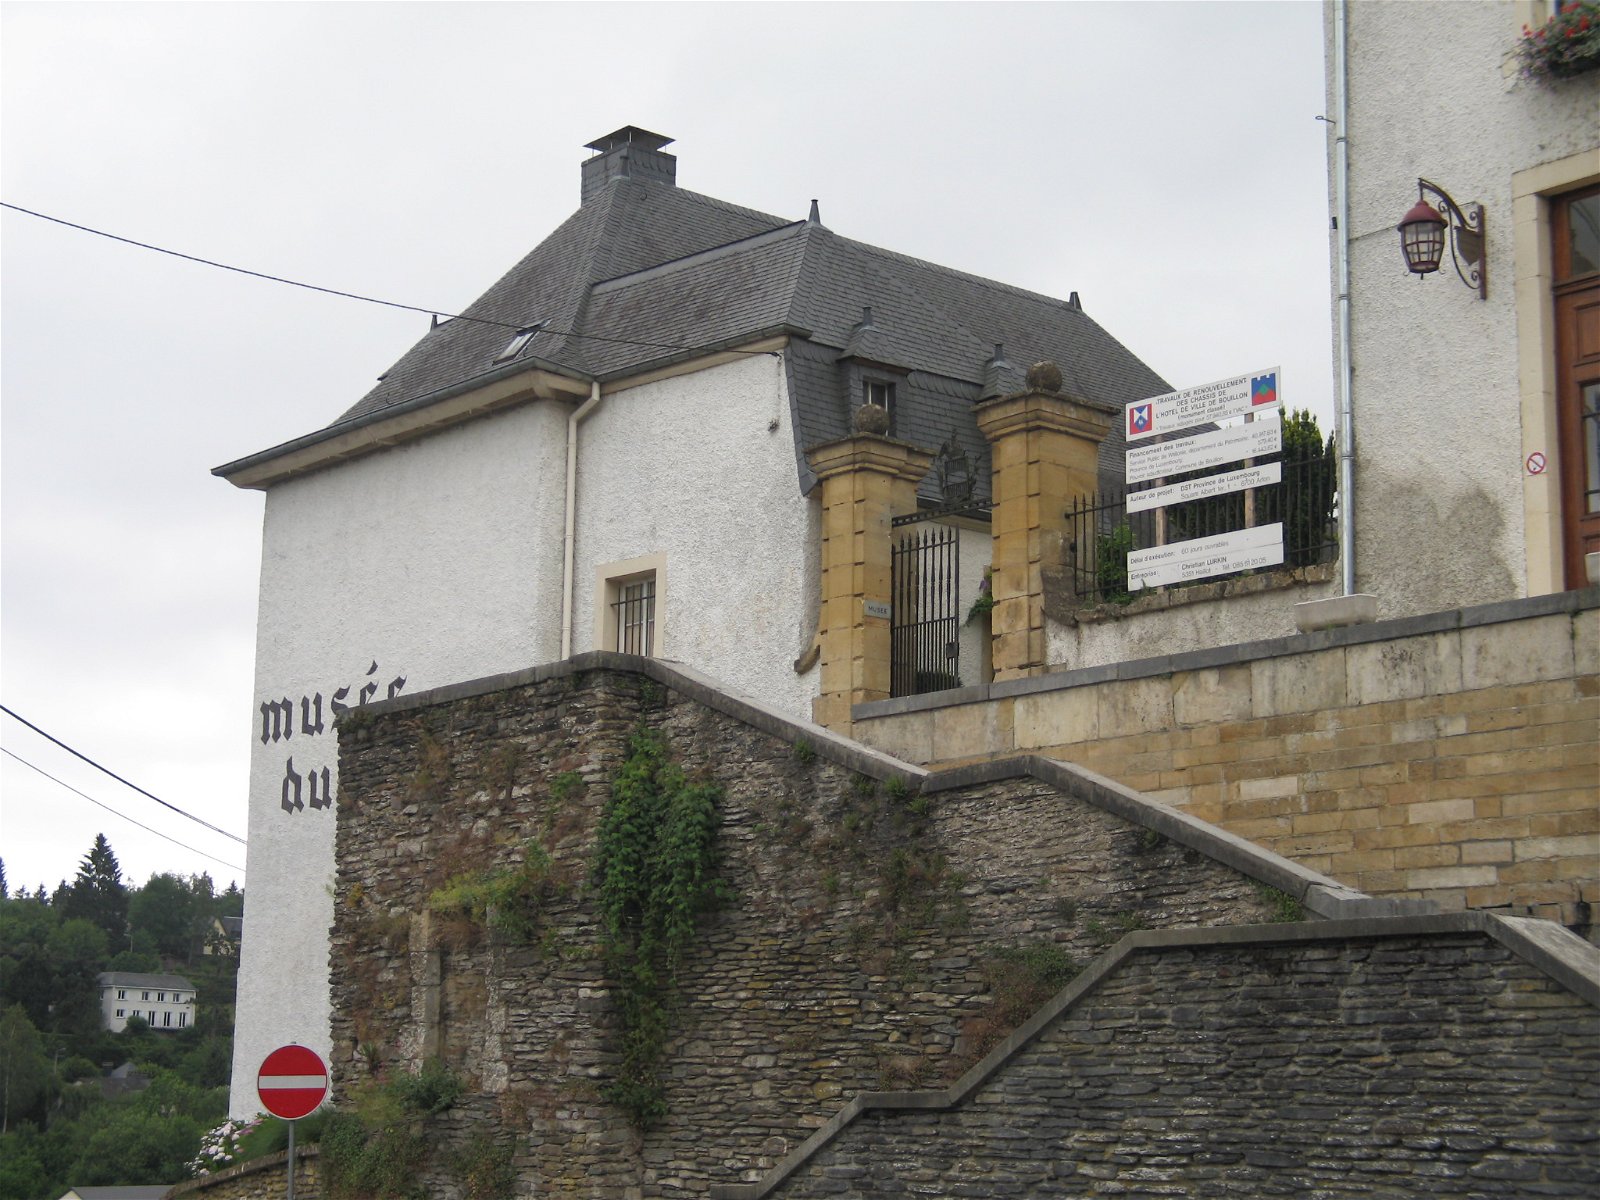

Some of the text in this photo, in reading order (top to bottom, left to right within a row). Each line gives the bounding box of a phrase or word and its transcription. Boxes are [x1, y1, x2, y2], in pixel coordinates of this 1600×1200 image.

[1183, 391, 1191, 399] DE
[1194, 377, 1247, 396] RENOUVELLEMENT
[1176, 399, 1189, 407] DES
[1191, 392, 1216, 404] CHASSIS
[1181, 405, 1189, 413] DE
[1191, 401, 1206, 410] VILLE
[1209, 399, 1217, 407] DE
[1219, 391, 1248, 404] BOUILLON
[1180, 483, 1192, 492] DST
[1193, 478, 1216, 489] Province
[1217, 476, 1225, 484] de
[1227, 470, 1260, 483] Luxembourg
[1181, 560, 1206, 571] Christian
[281, 755, 333, 815] du
